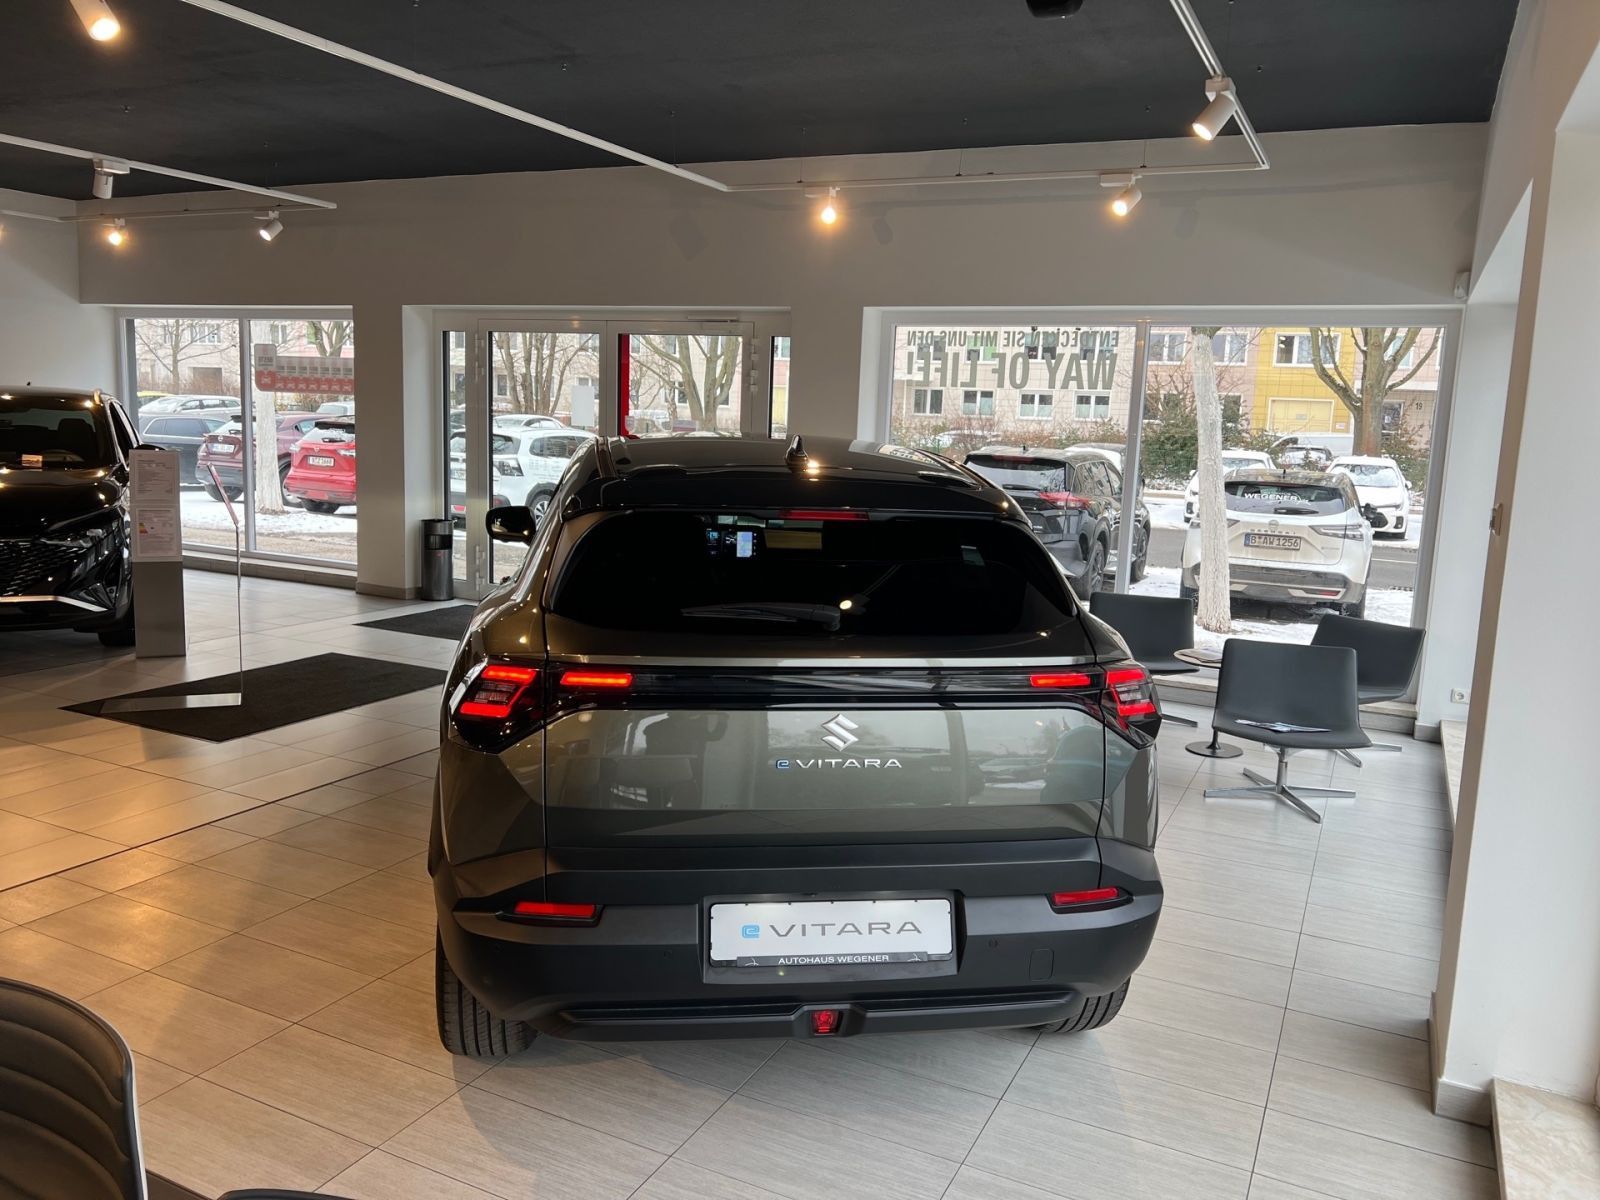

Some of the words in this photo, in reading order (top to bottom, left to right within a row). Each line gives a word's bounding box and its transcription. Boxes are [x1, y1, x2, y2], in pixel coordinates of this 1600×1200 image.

[1415, 402, 1423, 411] 19
[1244, 492, 1297, 501] WEGENER
[1250, 535, 1257, 544] B
[1262, 536, 1275, 546] AW
[1276, 537, 1299, 548] 1256
[795, 758, 903, 769] VITARA
[769, 921, 923, 938] VITARA
[778, 955, 836, 966] AUTOHAUS
[838, 954, 889, 964] WEGENER
